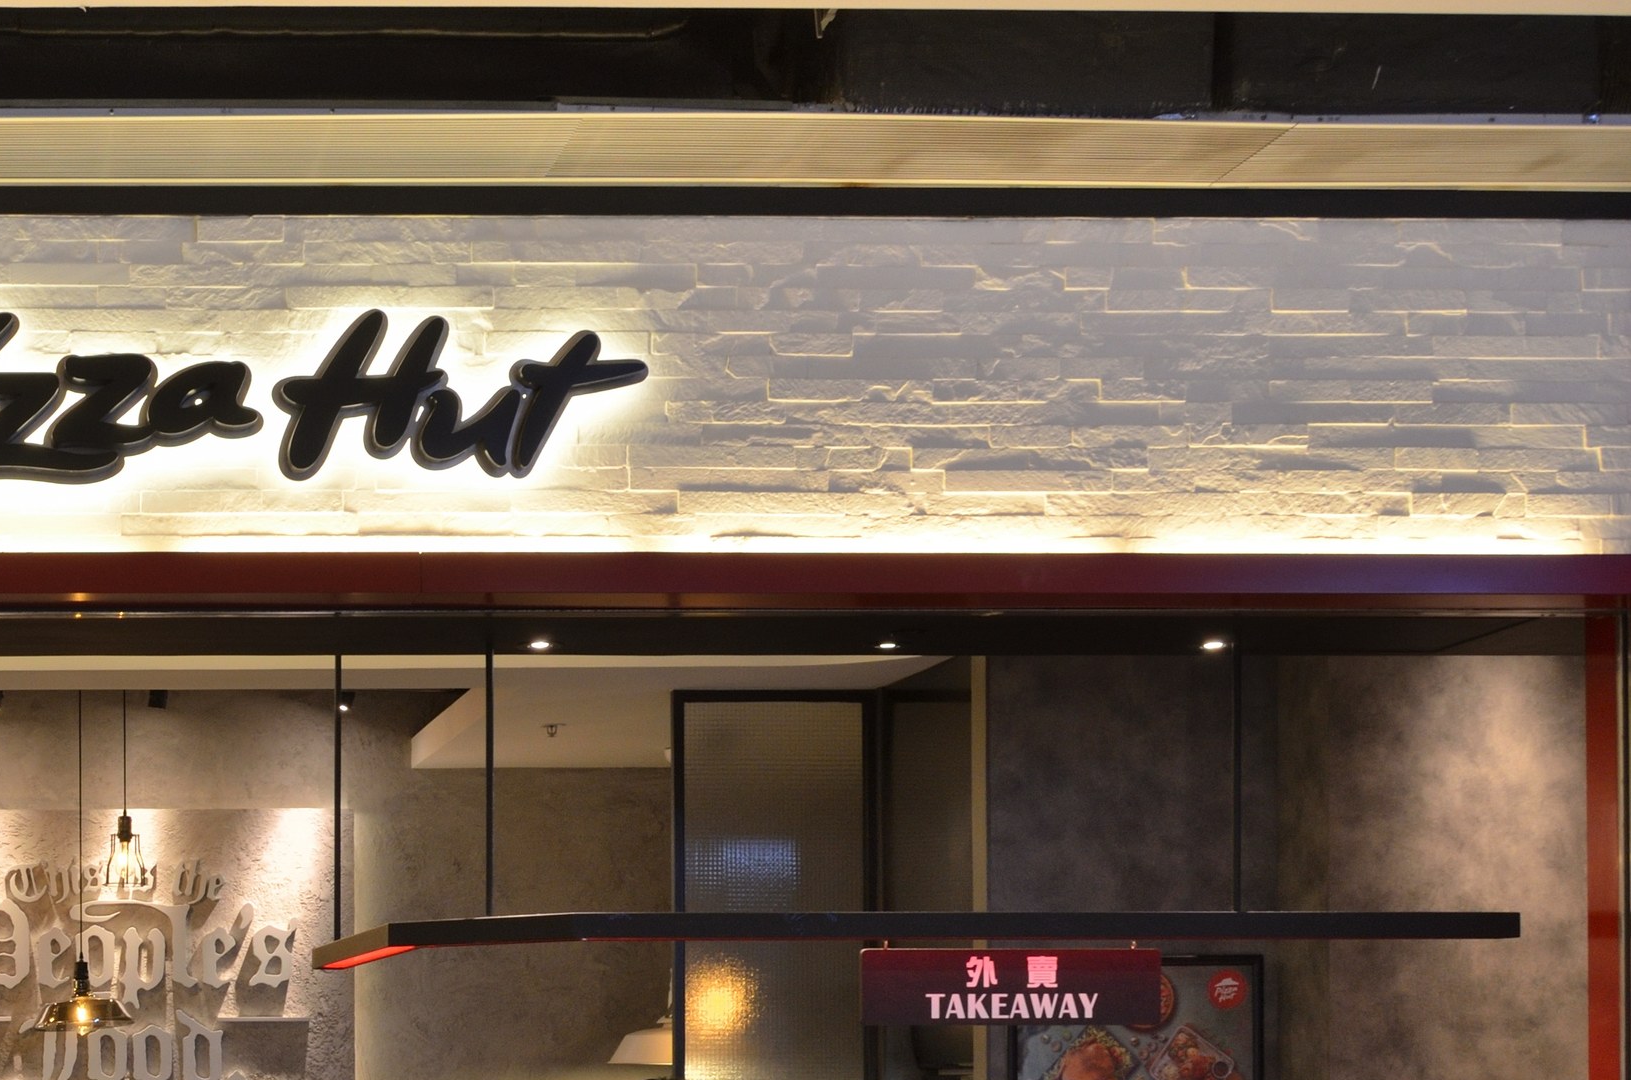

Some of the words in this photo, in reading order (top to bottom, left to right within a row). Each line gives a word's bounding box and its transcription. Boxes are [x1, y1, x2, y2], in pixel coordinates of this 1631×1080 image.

[272, 308, 649, 481] Hut
[9, 866, 102, 903] This
[174, 862, 225, 903] the
[925, 993, 1099, 1019] TAKEAWAY
